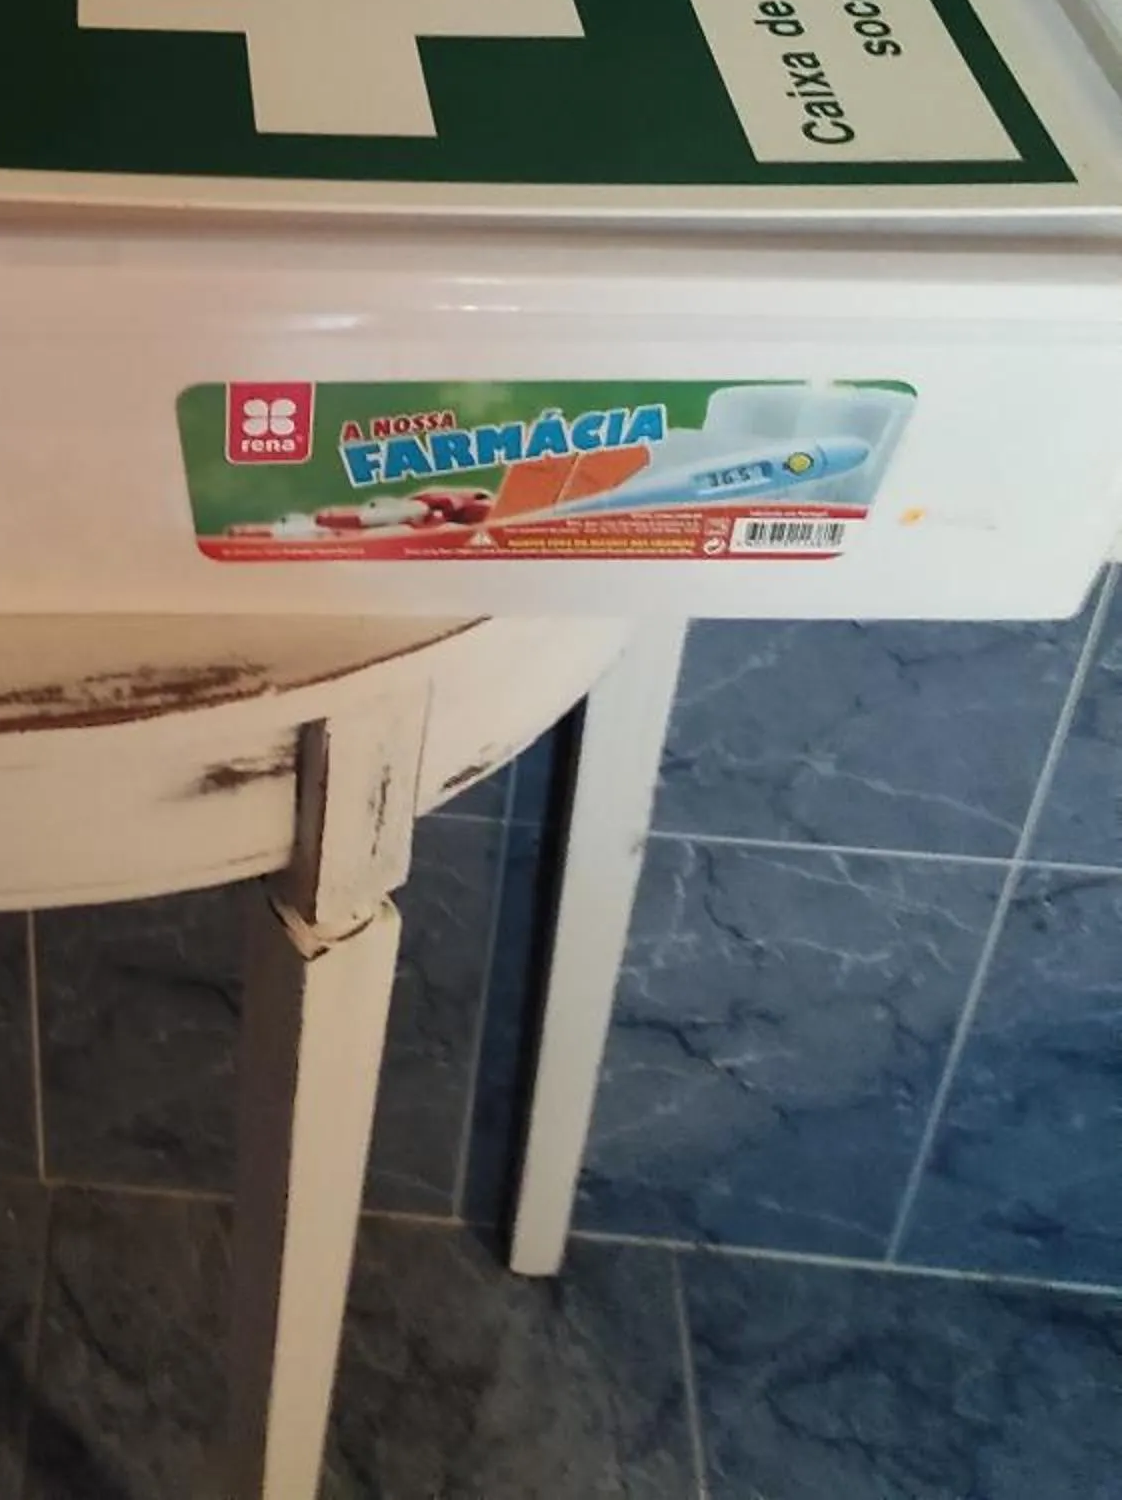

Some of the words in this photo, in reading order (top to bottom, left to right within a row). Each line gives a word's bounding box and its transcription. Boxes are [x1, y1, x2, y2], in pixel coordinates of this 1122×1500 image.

[754, 0, 805, 37] de
[782, 51, 855, 146] Caixa
[240, 436, 296, 453] rena
[342, 421, 361, 440] A
[372, 412, 455, 438] NOSSA
[341, 406, 665, 486] FARMÁCIA
